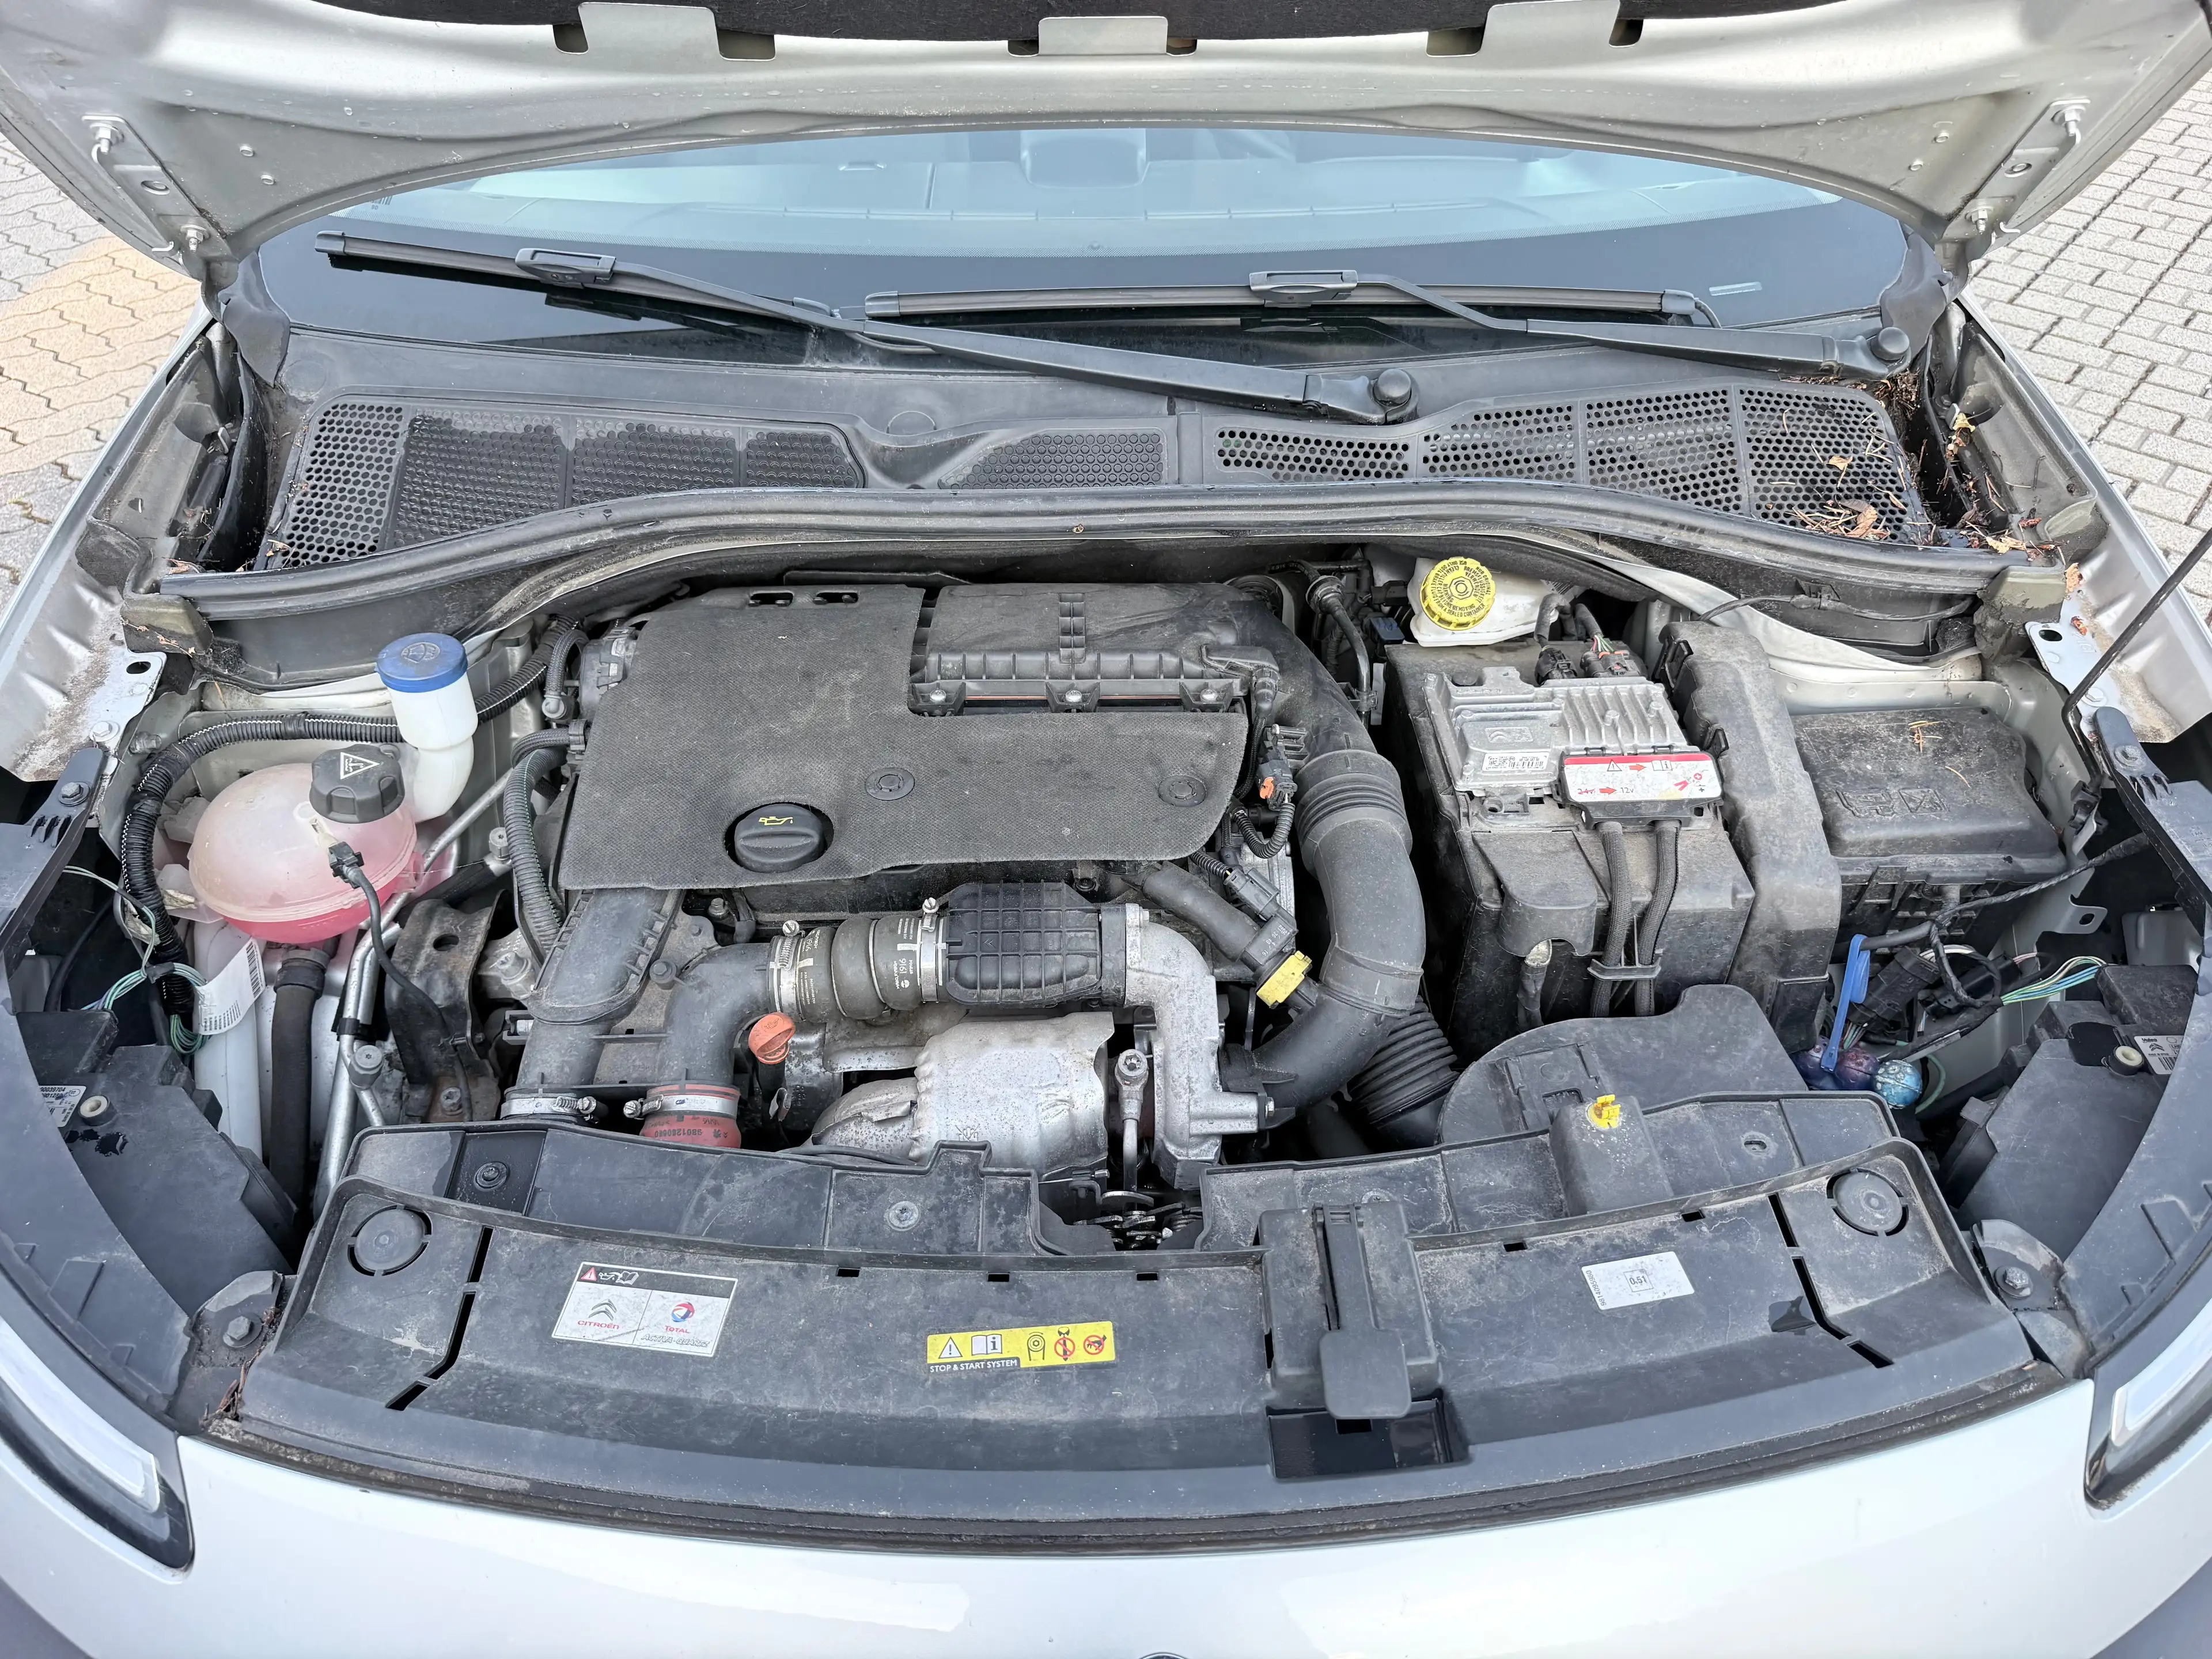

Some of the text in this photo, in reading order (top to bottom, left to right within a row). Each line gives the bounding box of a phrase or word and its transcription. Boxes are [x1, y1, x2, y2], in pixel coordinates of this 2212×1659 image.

[1446, 566, 1459, 575] CLEAN
[1476, 567, 1484, 575] NUR
[1431, 573, 1440, 585] BRAKE
[1438, 573, 1448, 585] FILLER
[1442, 584, 1454, 603] WARNING
[1433, 598, 1445, 609] FROM
[1439, 594, 1453, 608] BEFORE
[1446, 609, 1463, 618] SEALED
[1453, 604, 1476, 612] REMOVING
[1585, 1270, 1606, 1306] 9814095980
[665, 1325, 691, 1334] TOTAL
[930, 1363, 952, 1373] STOP
[960, 1361, 985, 1371] START
[987, 1359, 1018, 1369] SYSTEM
